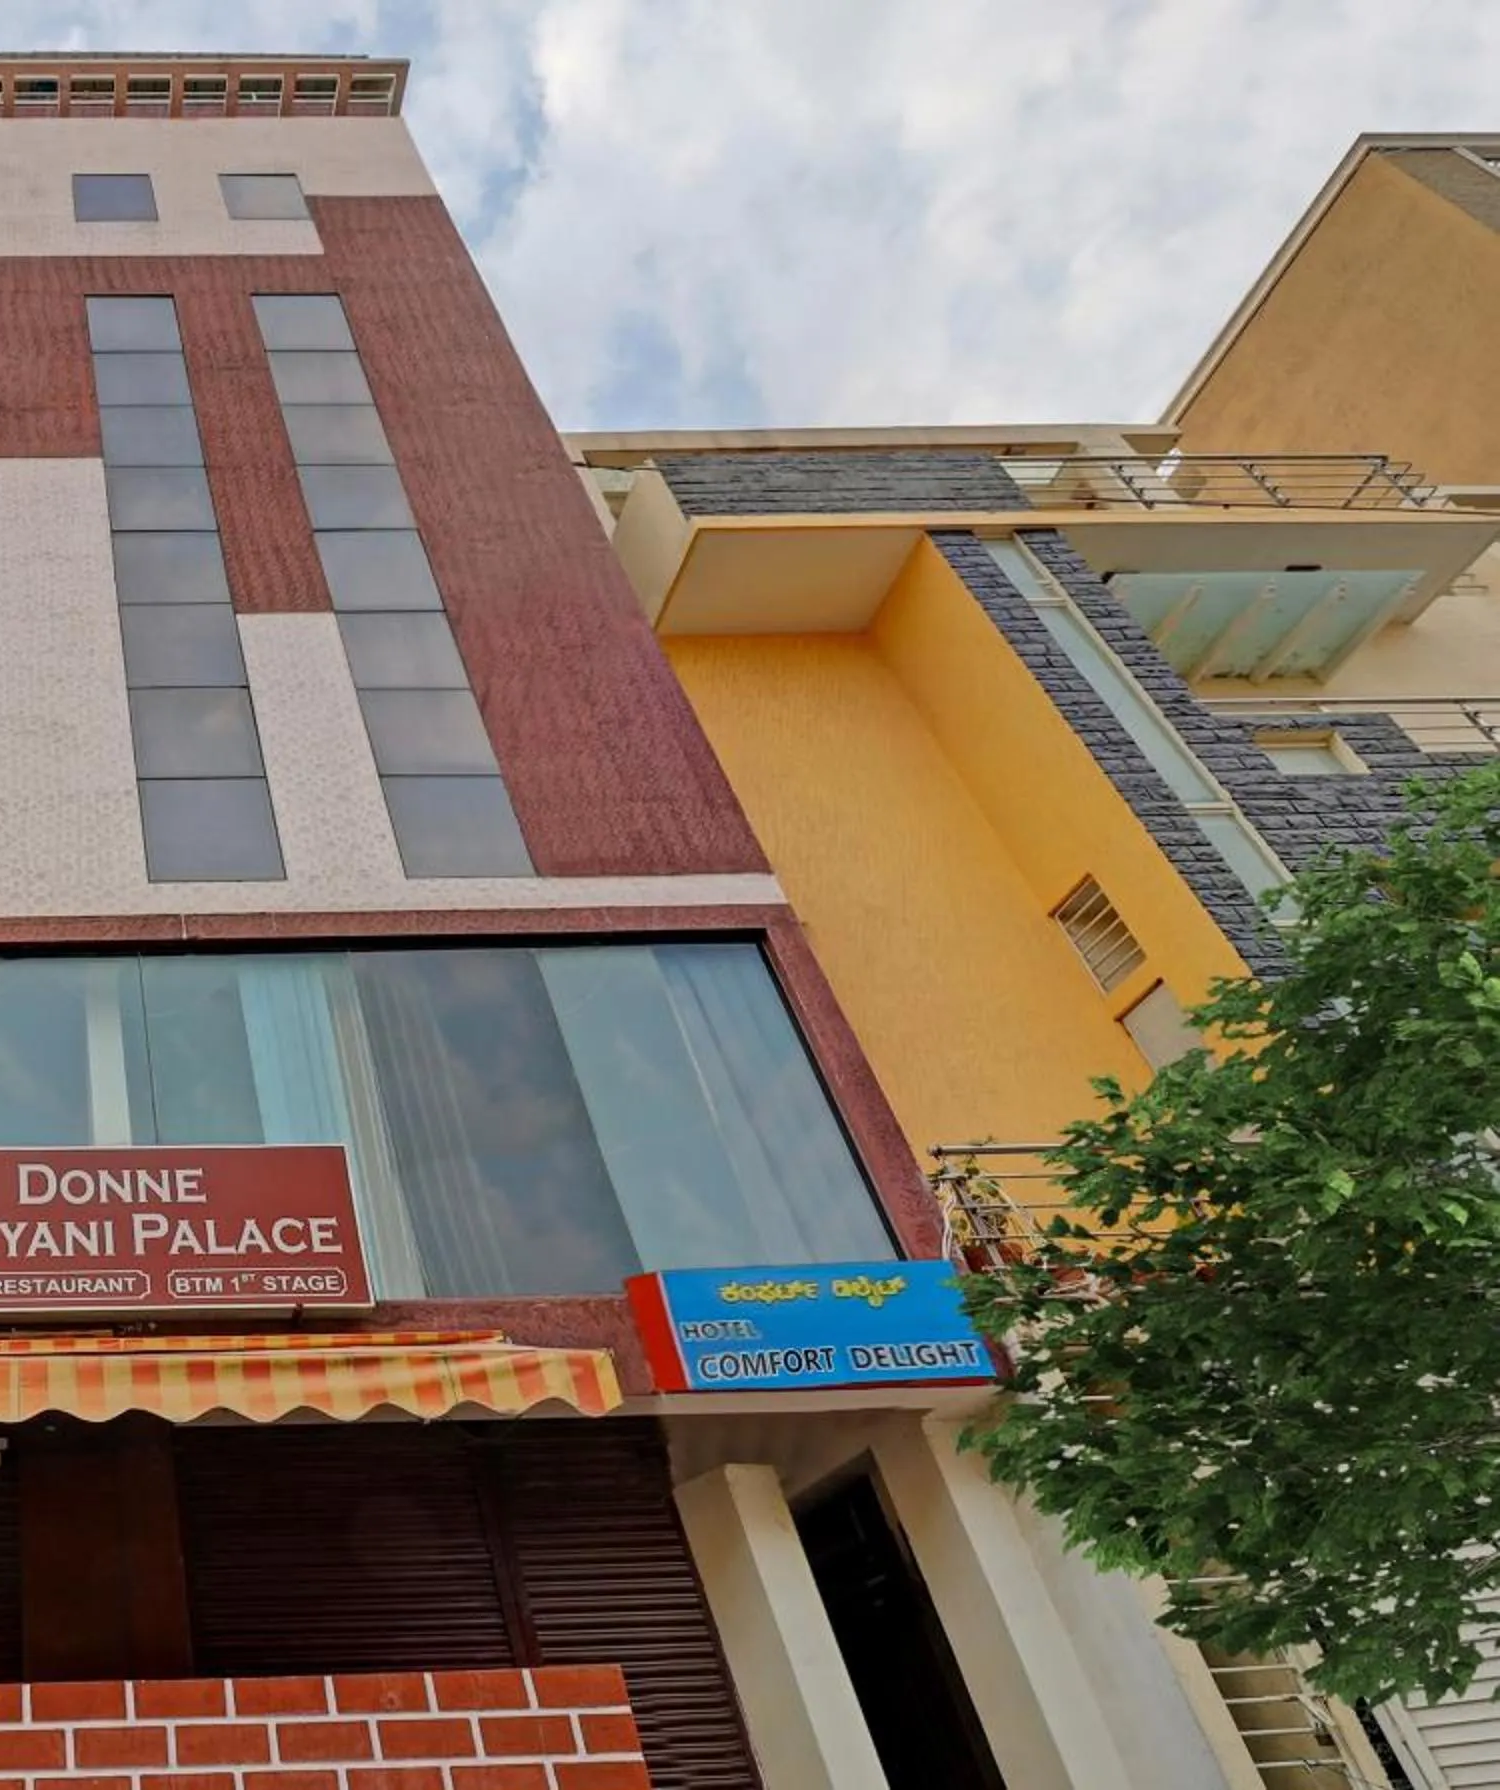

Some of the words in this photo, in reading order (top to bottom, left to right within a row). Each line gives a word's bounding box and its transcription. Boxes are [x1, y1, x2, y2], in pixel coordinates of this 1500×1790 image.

[18, 1163, 208, 1205] DONNE
[132, 1213, 343, 1256] PALACE
[175, 1277, 223, 1293] BTM
[263, 1275, 342, 1292] STAGE
[683, 1320, 759, 1341] HOTEL
[700, 1345, 835, 1380] COMFORT
[850, 1340, 981, 1371] DELIGHT
